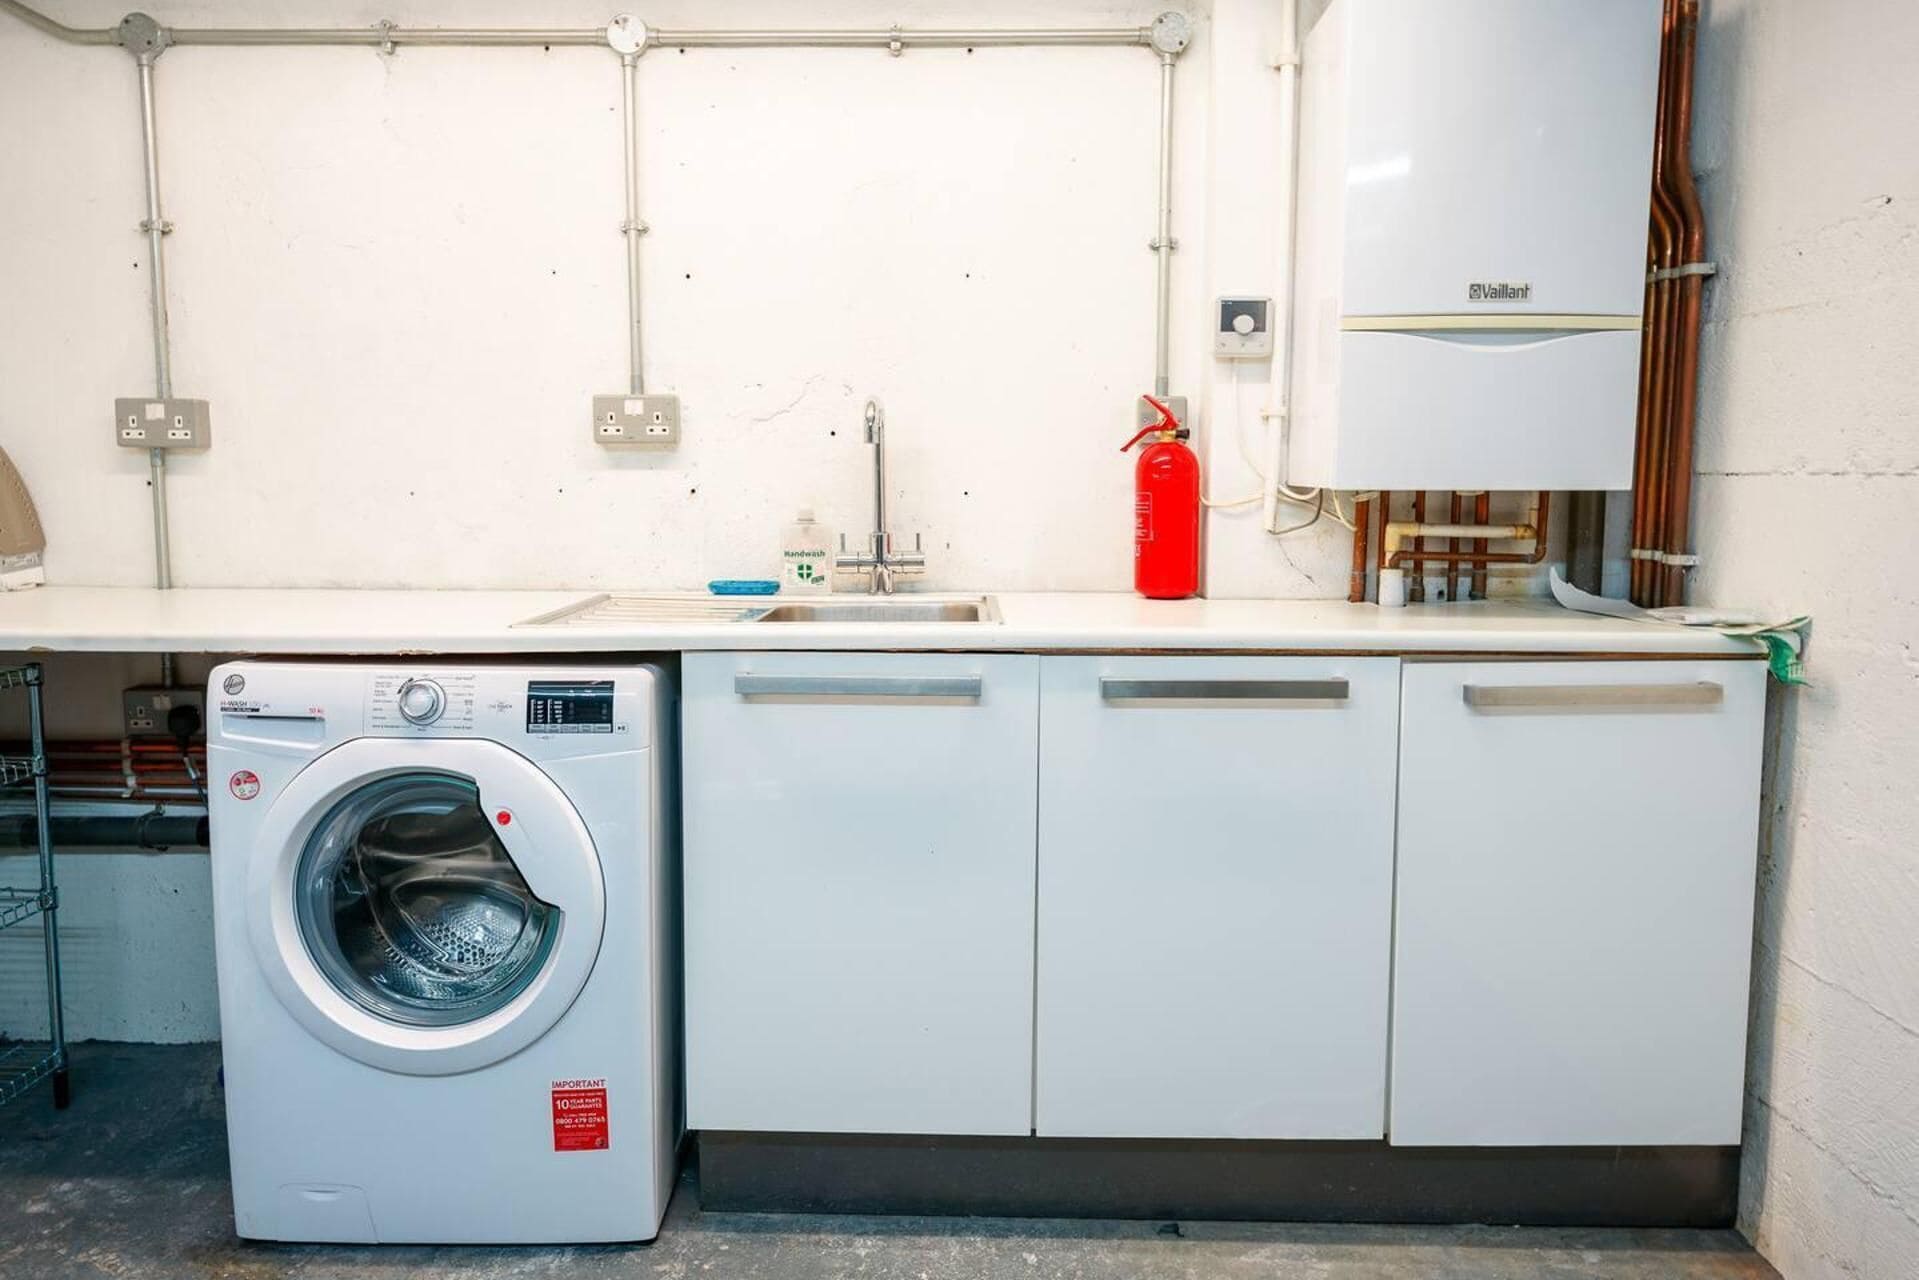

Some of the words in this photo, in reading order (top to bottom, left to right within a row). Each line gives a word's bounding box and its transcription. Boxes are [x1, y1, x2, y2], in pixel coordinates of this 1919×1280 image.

[1482, 283, 1530, 299] Vaillant
[784, 550, 826, 558] Handwash
[552, 1079, 606, 1088] IMPORTANT
[555, 1099, 569, 1110] 10
